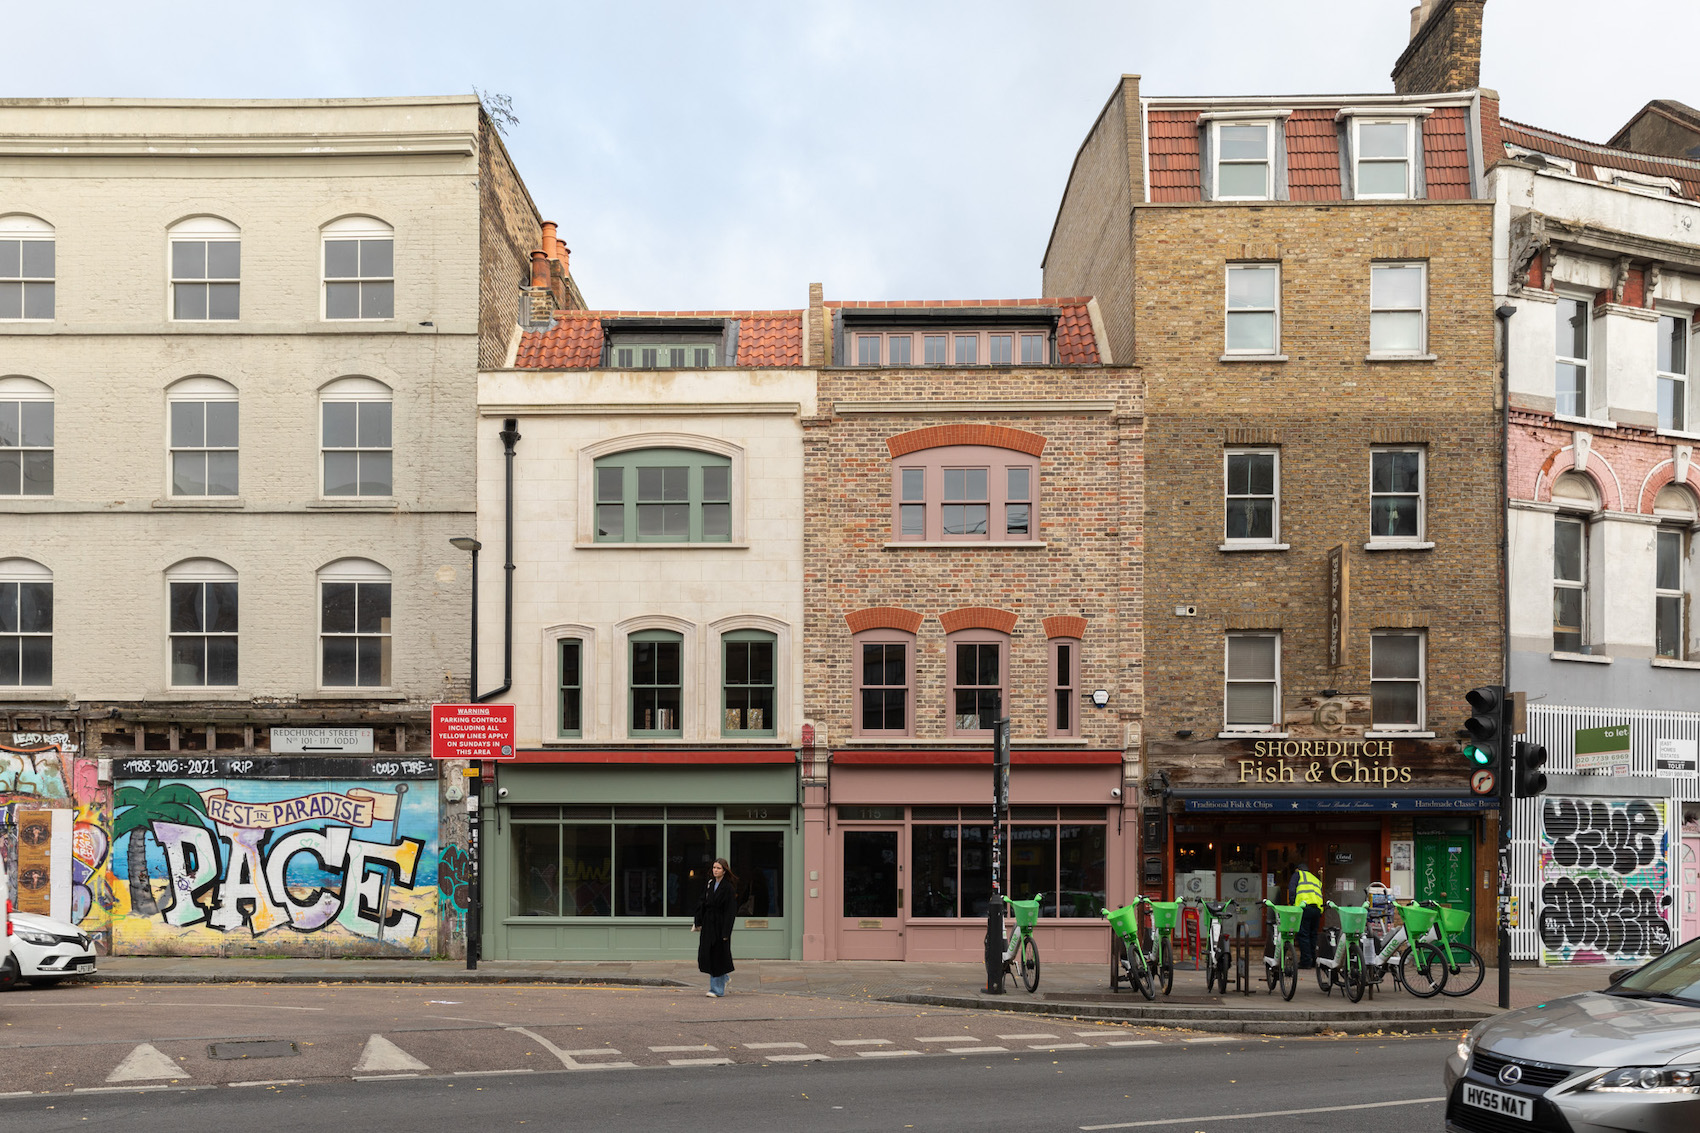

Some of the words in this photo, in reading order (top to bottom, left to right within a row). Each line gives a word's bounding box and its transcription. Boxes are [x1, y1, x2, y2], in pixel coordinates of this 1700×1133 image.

[1331, 555, 1339, 595] Fish
[1331, 612, 1339, 665] Chips
[1254, 740, 1394, 758] SHOREDITCH
[1238, 758, 1295, 783] Fish
[1304, 761, 1324, 783] &
[1330, 758, 1412, 789] Chips
[210, 800, 254, 826] REST
[256, 812, 268, 820] IN
[273, 796, 366, 824] PARADISE
[746, 808, 768, 819] 113
[860, 809, 882, 819] 115
[1253, 800, 1273, 809] Chips
[152, 820, 426, 938] PACE
[1381, 938, 1400, 958] Lime
[1502, 1096, 1526, 1116] NAT
